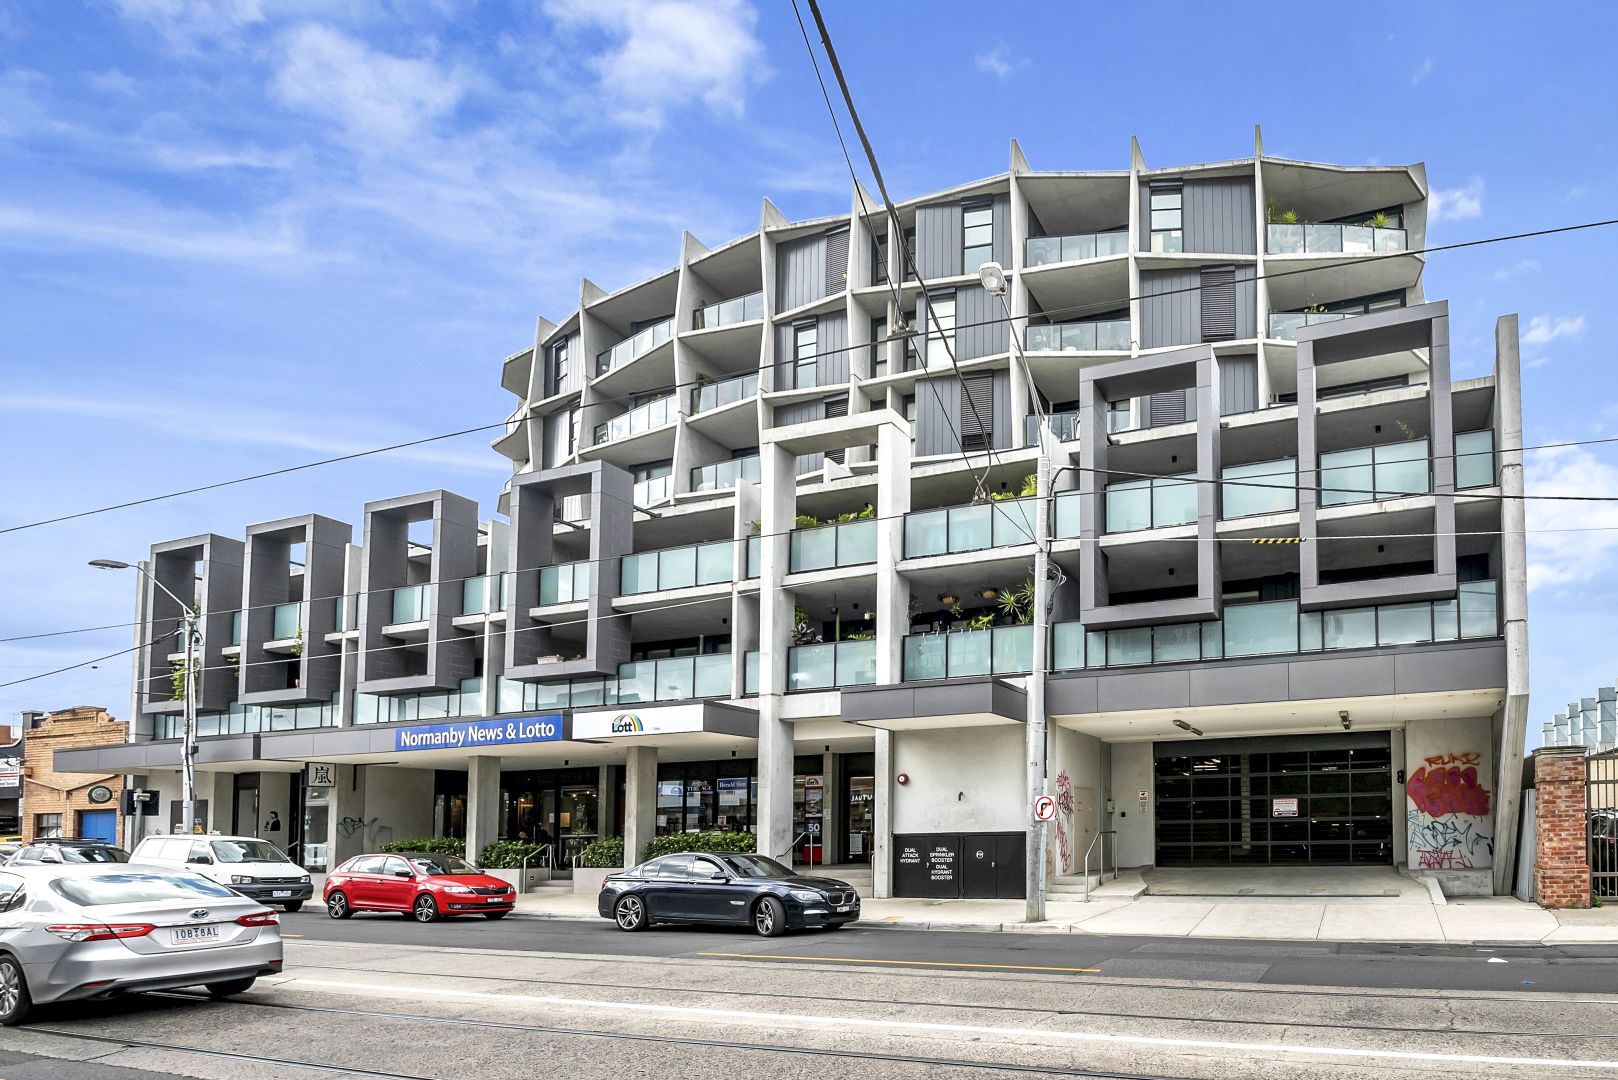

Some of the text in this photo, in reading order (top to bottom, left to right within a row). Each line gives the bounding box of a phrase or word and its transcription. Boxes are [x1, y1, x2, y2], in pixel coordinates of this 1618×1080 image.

[401, 722, 555, 747] Normanby News & Lotto
[611, 721, 633, 733] Lott
[312, 766, 332, 784] 嵐
[808, 823, 820, 831] 50
